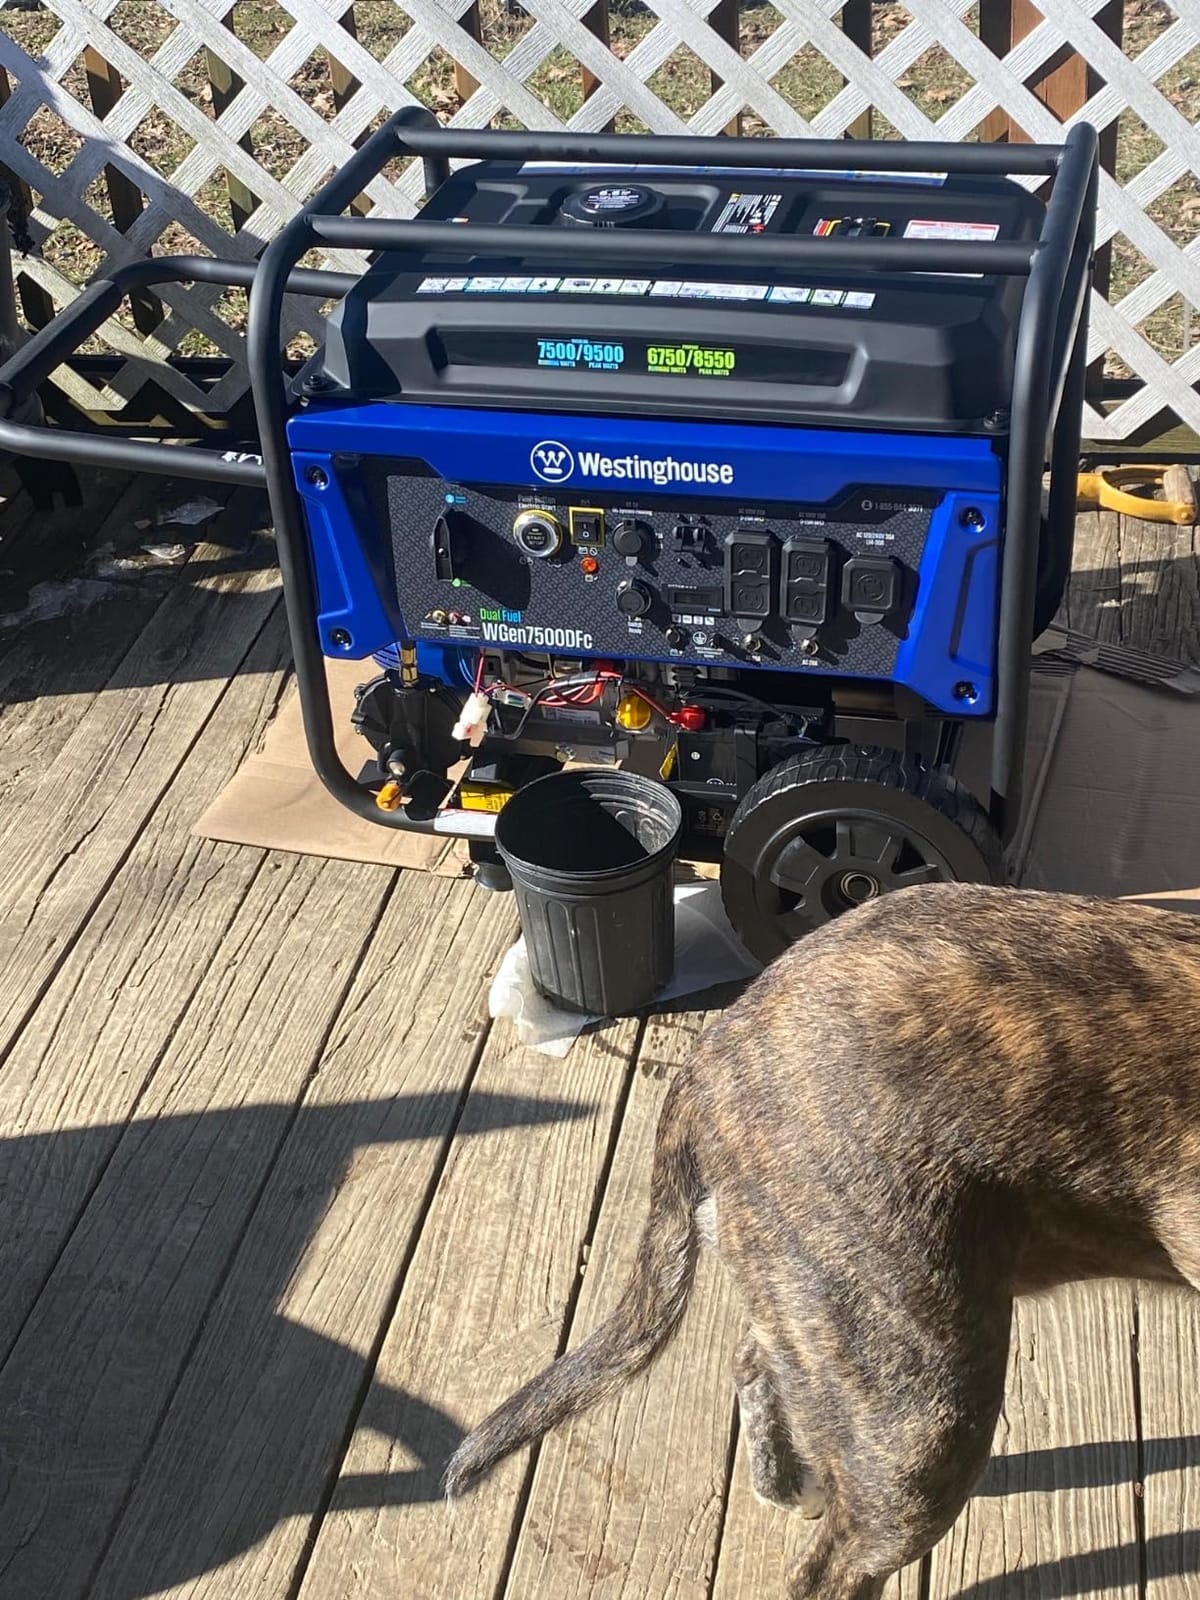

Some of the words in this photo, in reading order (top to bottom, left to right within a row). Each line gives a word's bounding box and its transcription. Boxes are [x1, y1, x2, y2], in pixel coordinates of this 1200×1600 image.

[537, 341, 624, 363] 7500/9500
[647, 347, 735, 370] 6750/8550
[578, 452, 734, 485] Westinghouse
[479, 608, 501, 620] Dual
[502, 608, 522, 622] Fuel
[482, 622, 593, 649] WGen7500DFc
